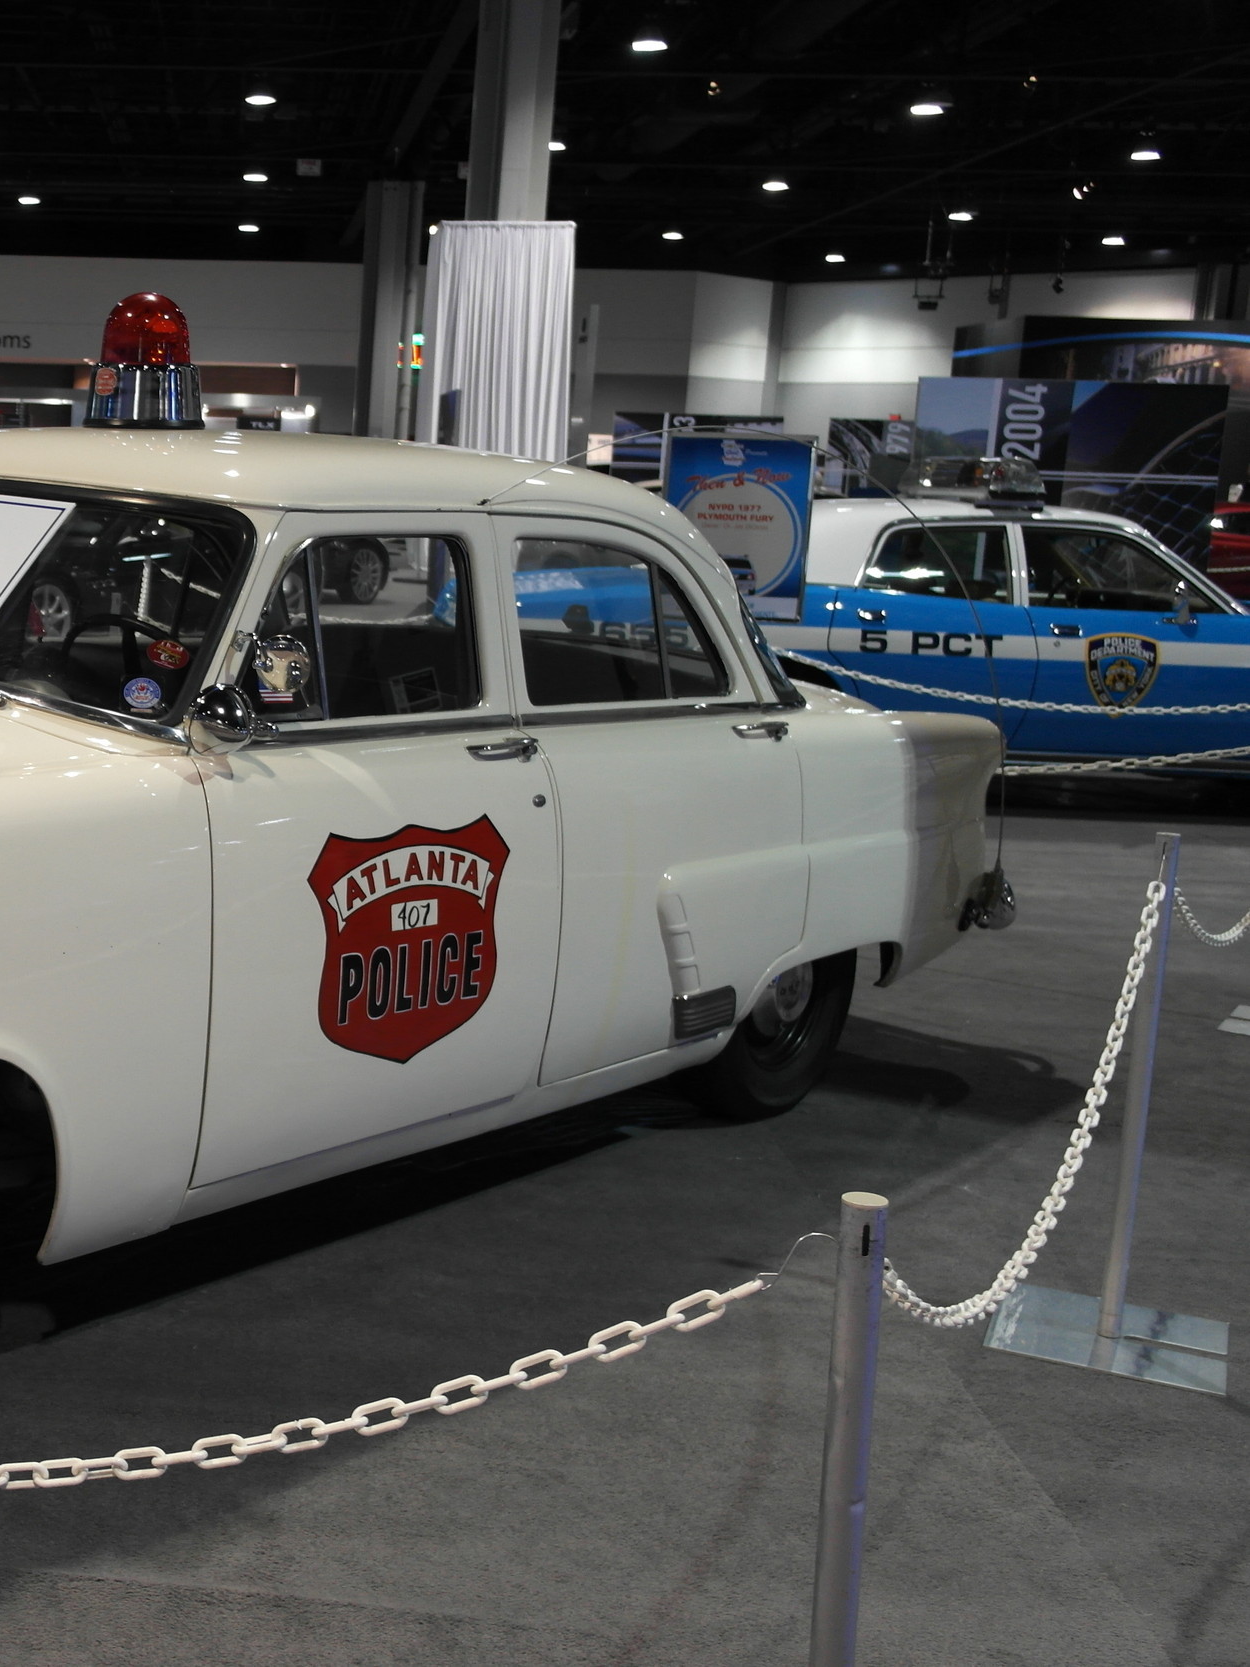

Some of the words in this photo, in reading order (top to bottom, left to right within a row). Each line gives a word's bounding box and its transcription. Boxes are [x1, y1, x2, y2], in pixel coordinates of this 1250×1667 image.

[250, 421, 276, 430] TLX
[1000, 382, 1049, 461] 2004
[885, 421, 911, 455] 979
[696, 512, 747, 521] PLYMOUTH
[749, 514, 775, 523] FURY
[708, 503, 735, 512] NYPD
[860, 630, 888, 653] 5
[911, 632, 1003, 659] PCT
[1090, 645, 1155, 662] DEPARTMENT
[1104, 637, 1142, 648] POLICE
[347, 850, 479, 911] ATLANTA
[398, 902, 431, 930] 407
[337, 930, 483, 1026] POLICE
